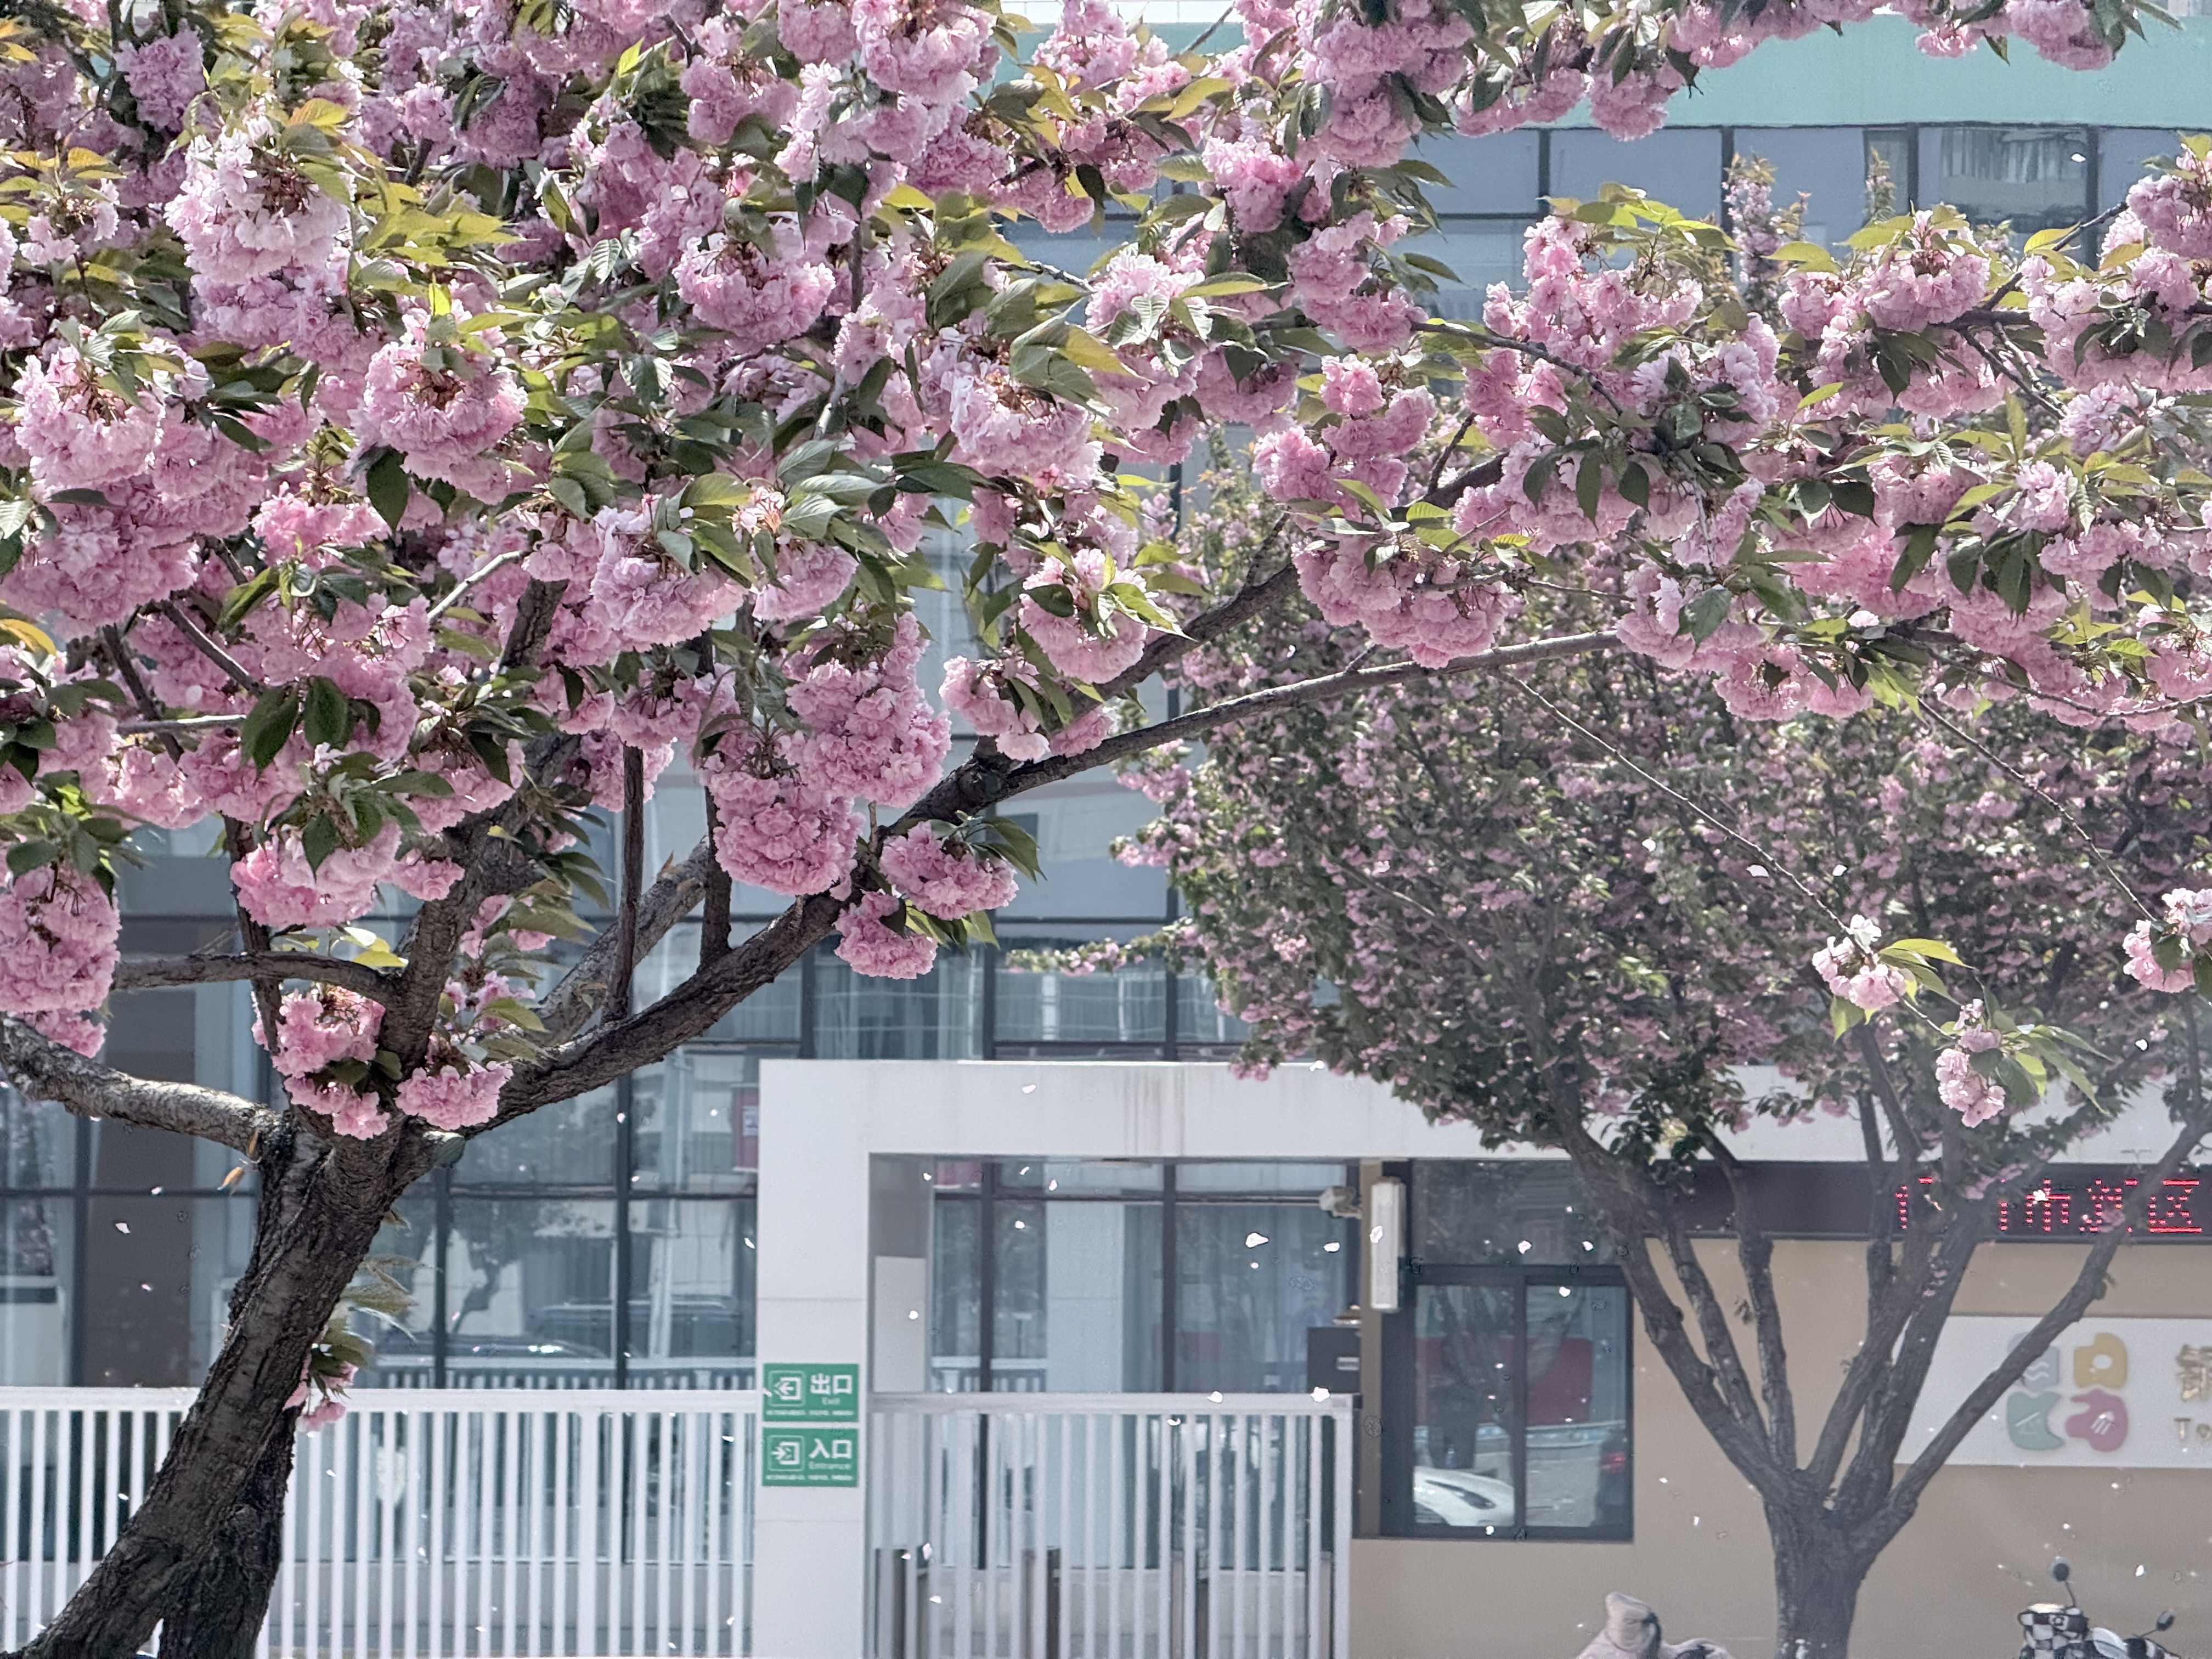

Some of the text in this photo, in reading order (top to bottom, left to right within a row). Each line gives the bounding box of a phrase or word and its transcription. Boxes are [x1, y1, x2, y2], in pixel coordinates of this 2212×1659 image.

[810, 1373, 853, 1395] 出口
[808, 1438, 852, 1459] 入口
[808, 1462, 851, 1470] Entrance
